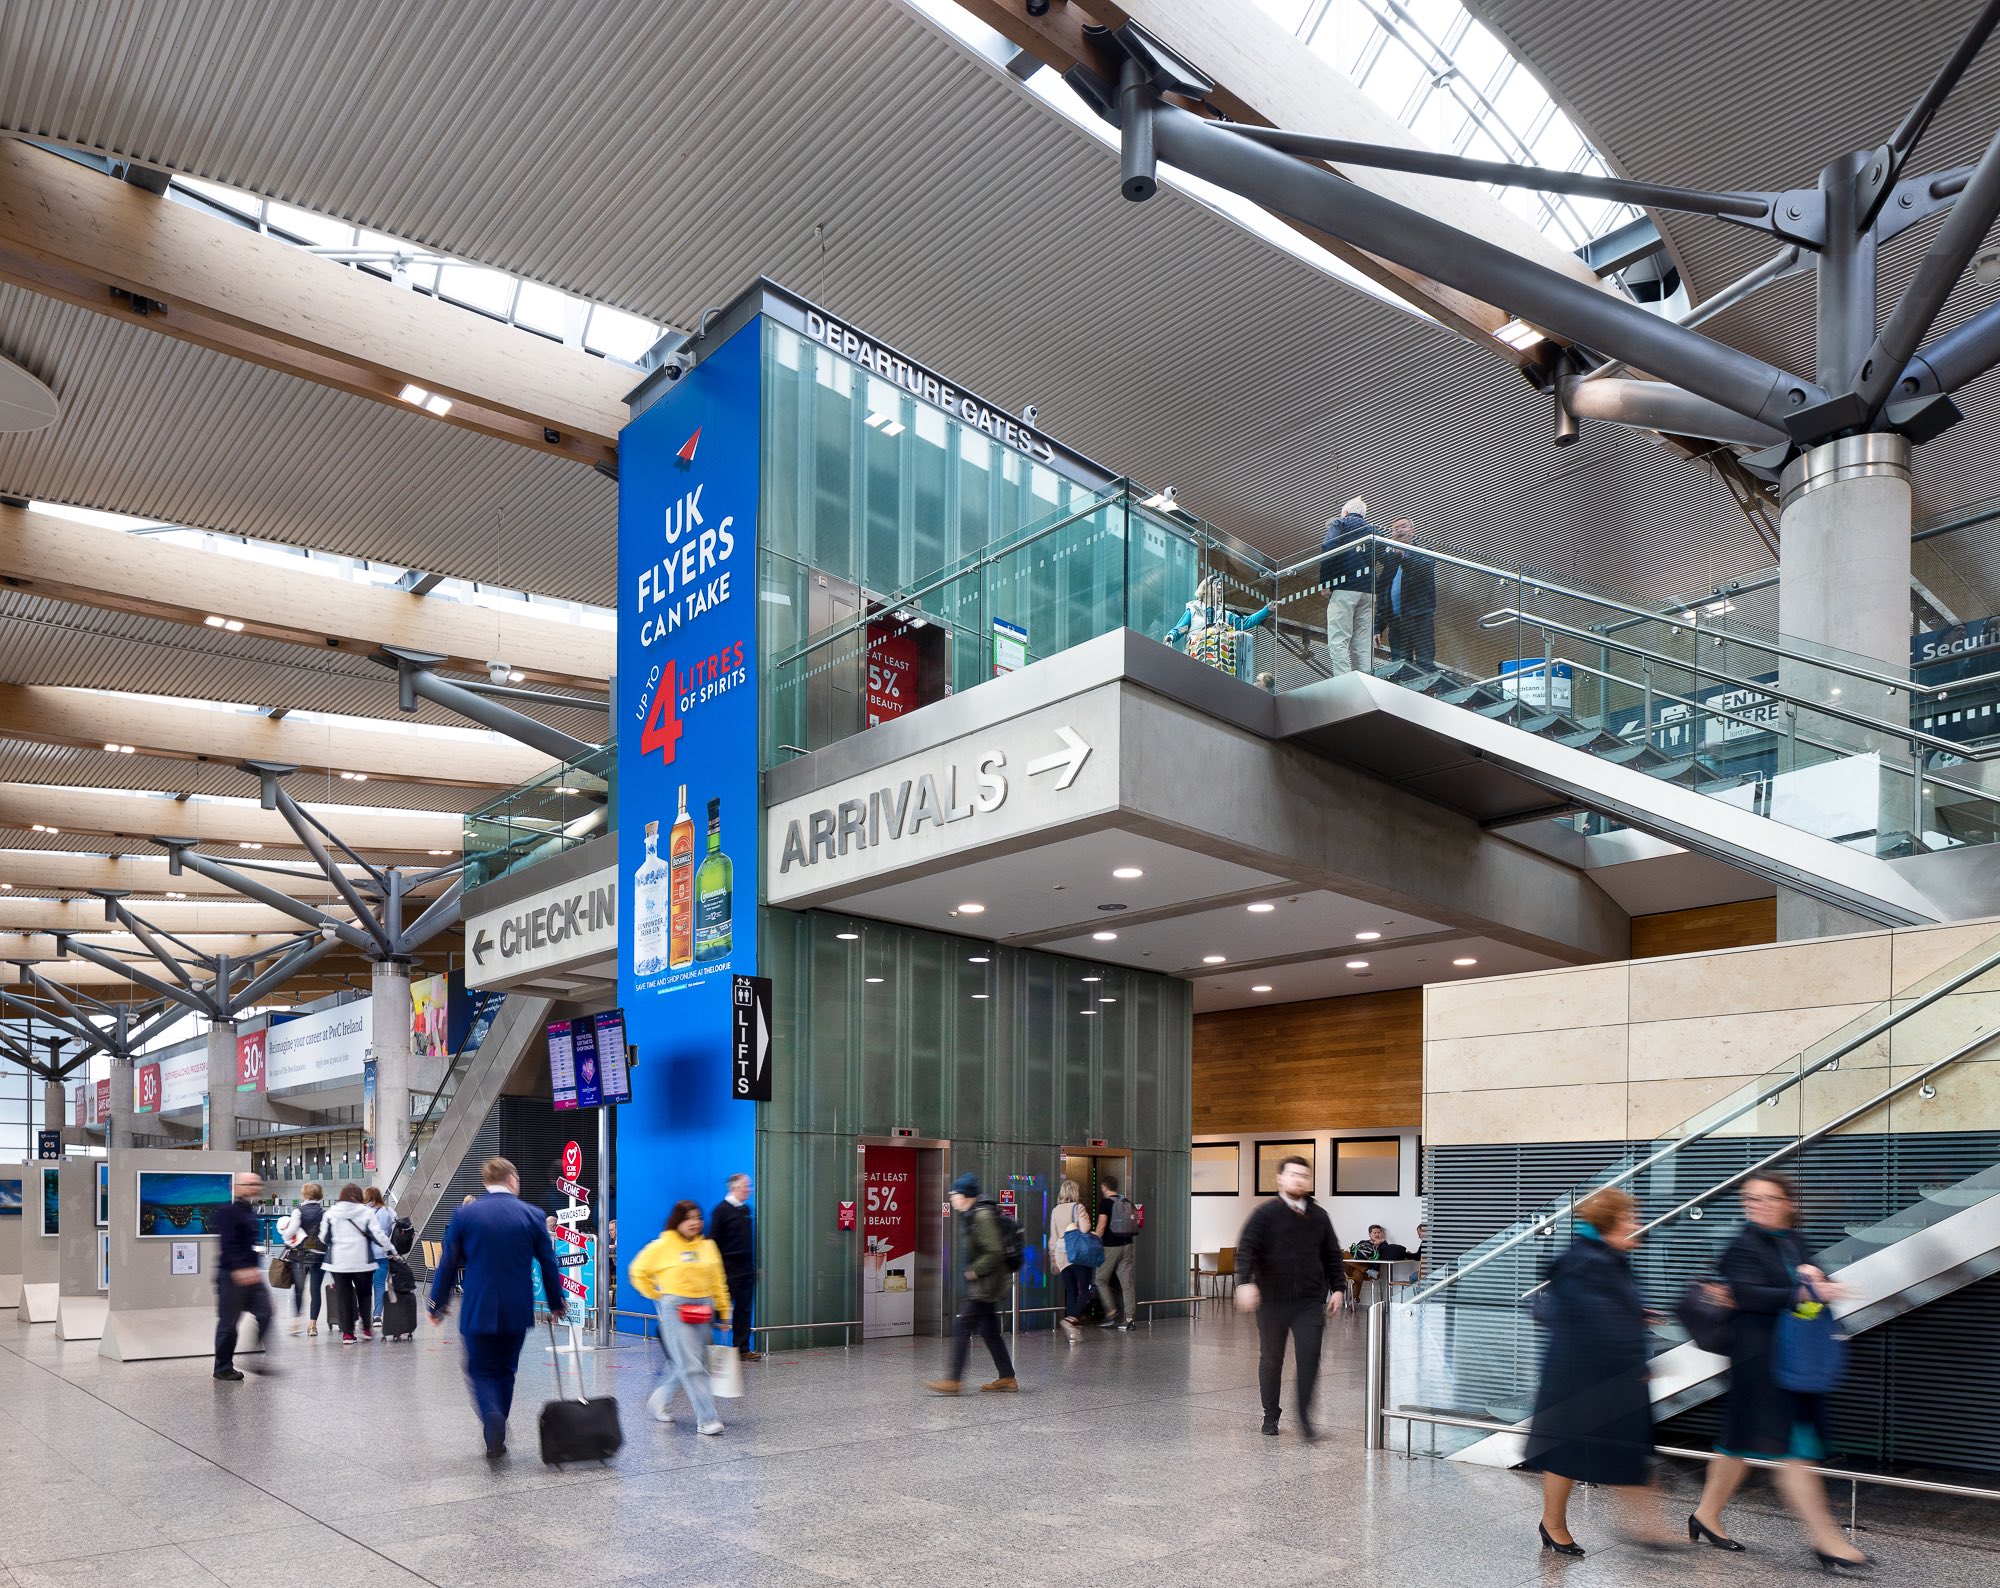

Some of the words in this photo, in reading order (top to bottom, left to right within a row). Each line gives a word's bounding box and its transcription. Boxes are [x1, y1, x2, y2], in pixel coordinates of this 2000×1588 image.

[806, 310, 955, 413] DEPARTURE
[961, 397, 1032, 453] GATES
[665, 483, 704, 544] UK
[638, 516, 734, 614] FLYERS
[640, 602, 681, 647] CAN
[686, 571, 731, 621] TAKE
[1922, 627, 2000, 660] Securi
[679, 640, 744, 696] LITRES
[871, 651, 882, 661] AT
[884, 655, 910, 671] LEAST
[635, 693, 648, 720] UP
[646, 665, 659, 690] TO
[680, 691, 697, 712] OF
[700, 667, 746, 703] SPIRITS
[870, 695, 903, 712] BEAUTY
[641, 659, 683, 766] 4
[779, 750, 1009, 874] ARRIVALS
[500, 884, 616, 958] CHECK-IN
[635, 983, 647, 991] SAVE
[646, 981, 656, 989] TIME
[656, 977, 667, 987] AND
[667, 974, 680, 984] SHOP
[680, 969, 698, 980] ONLINE
[698, 968, 704, 977] AT
[269, 1037, 294, 1055] Reimagine
[293, 1036, 306, 1052] your
[305, 1032, 322, 1045] career
[322, 1029, 328, 1041] at
[328, 1022, 342, 1040] PwC
[342, 1016, 363, 1036] Ireland
[737, 1009, 749, 1094] LIFTS
[243, 1044, 264, 1078] 30%
[143, 1073, 157, 1101] 30%
[562, 1181, 581, 1198] ROME
[870, 1173, 880, 1181] AT
[882, 1173, 908, 1182] LEAST
[560, 1208, 587, 1220] NEWCASTLE
[868, 1216, 901, 1225] BEAUTY
[564, 1230, 580, 1245] FARO
[561, 1254, 584, 1266] VALENCIA
[563, 1277, 580, 1294] PARIS
